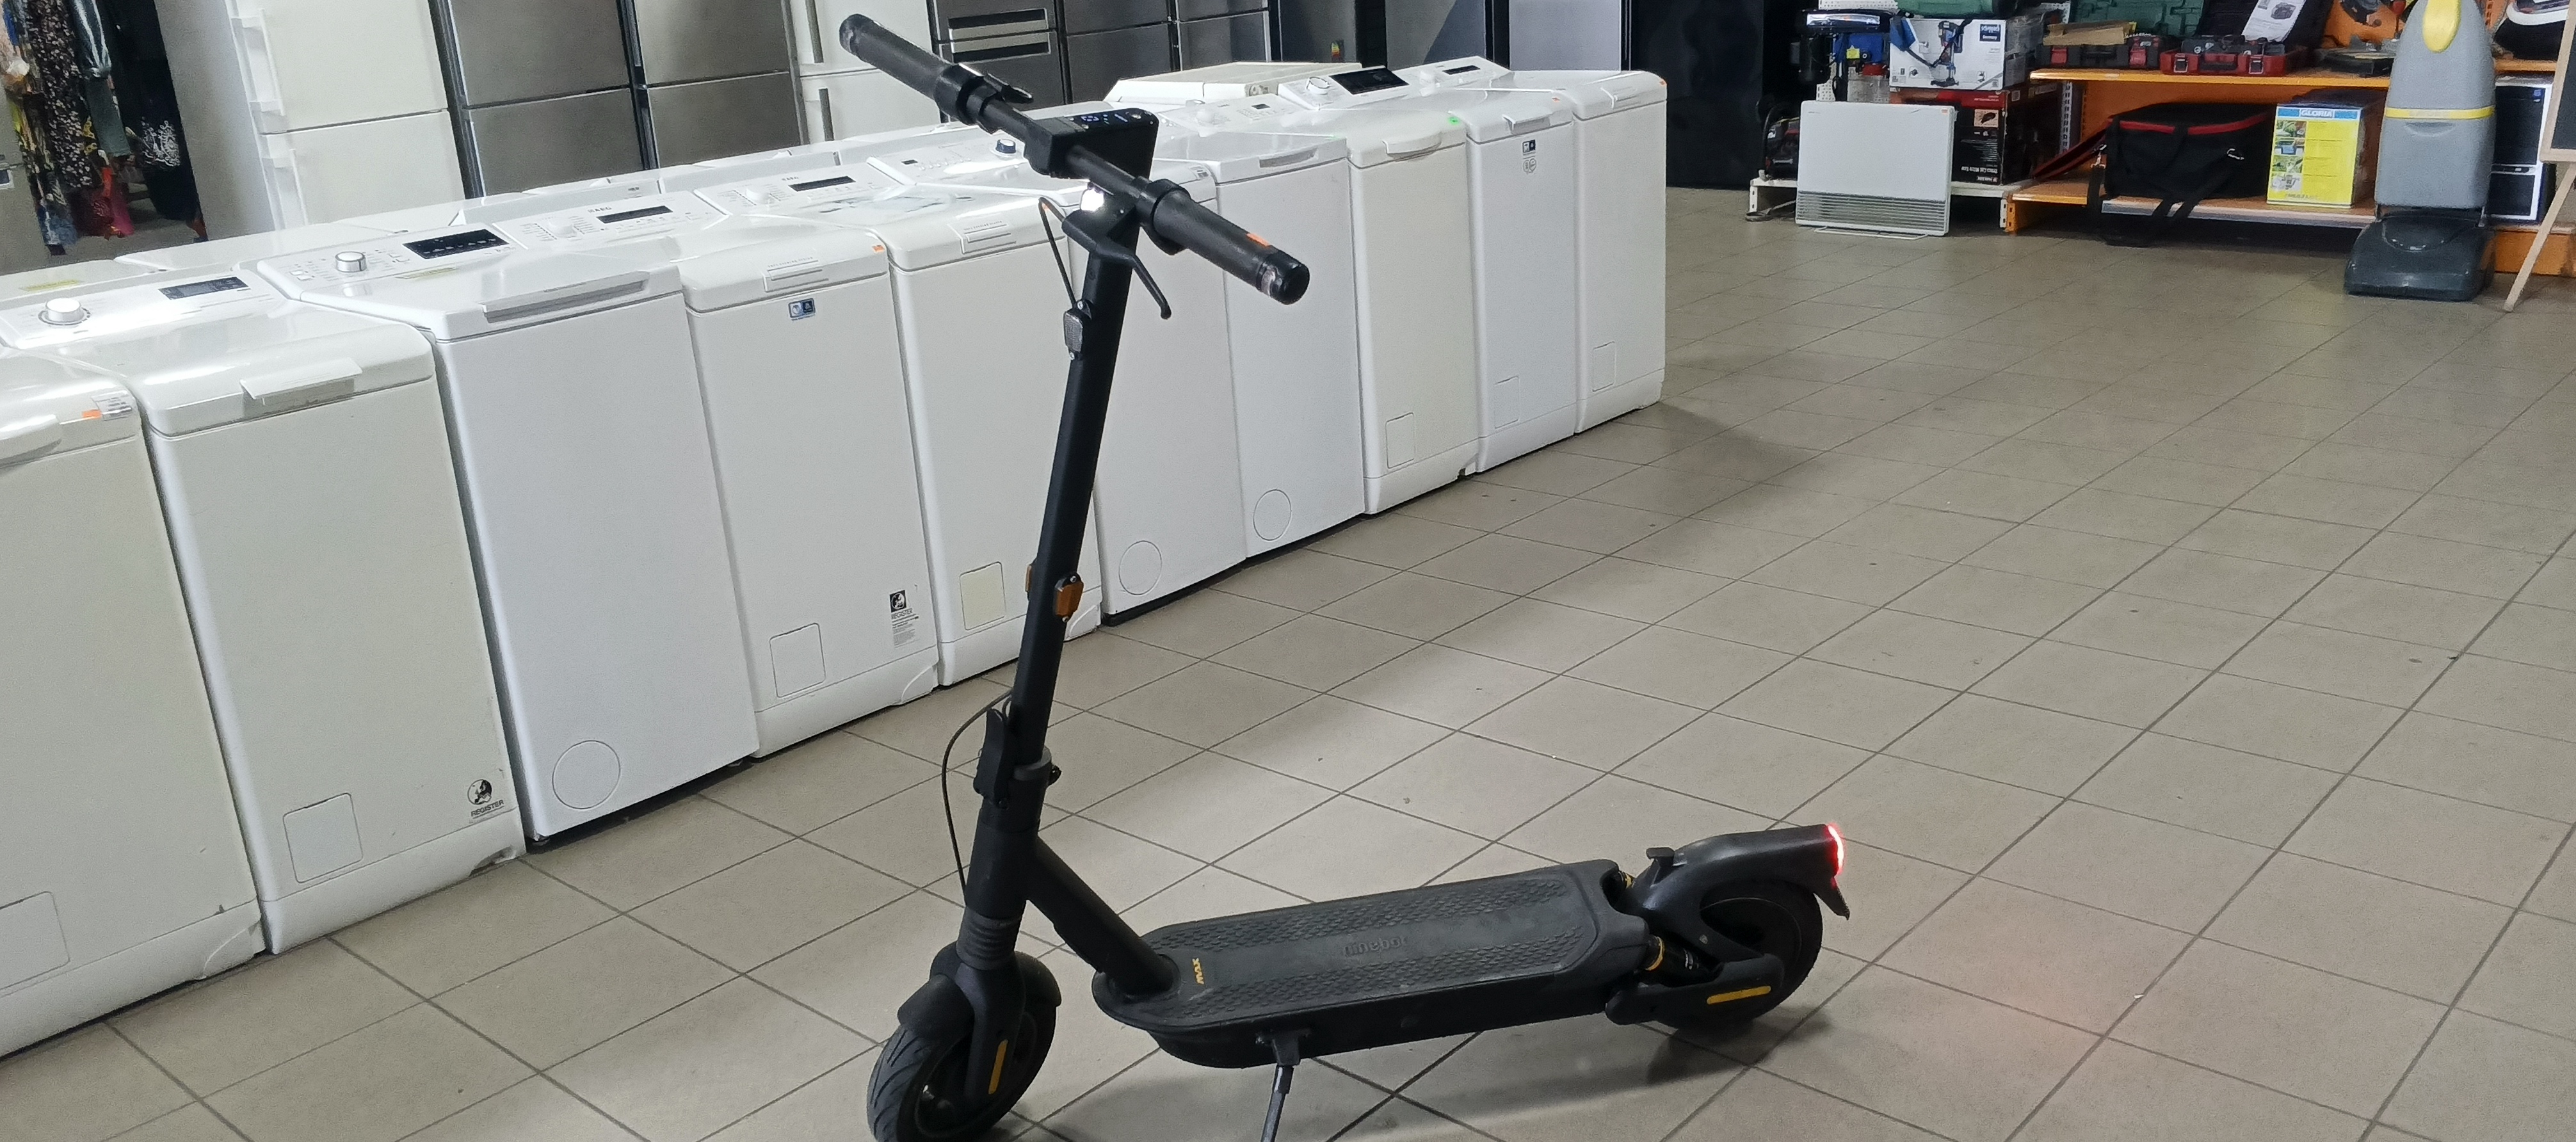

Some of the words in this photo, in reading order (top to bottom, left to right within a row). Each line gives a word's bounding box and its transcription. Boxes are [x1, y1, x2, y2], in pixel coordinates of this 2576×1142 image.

[2301, 109, 2333, 117] GLORIA
[891, 608, 913, 620] REGISTER
[471, 799, 504, 817] REGISTER
[1192, 958, 1205, 985] MAX
